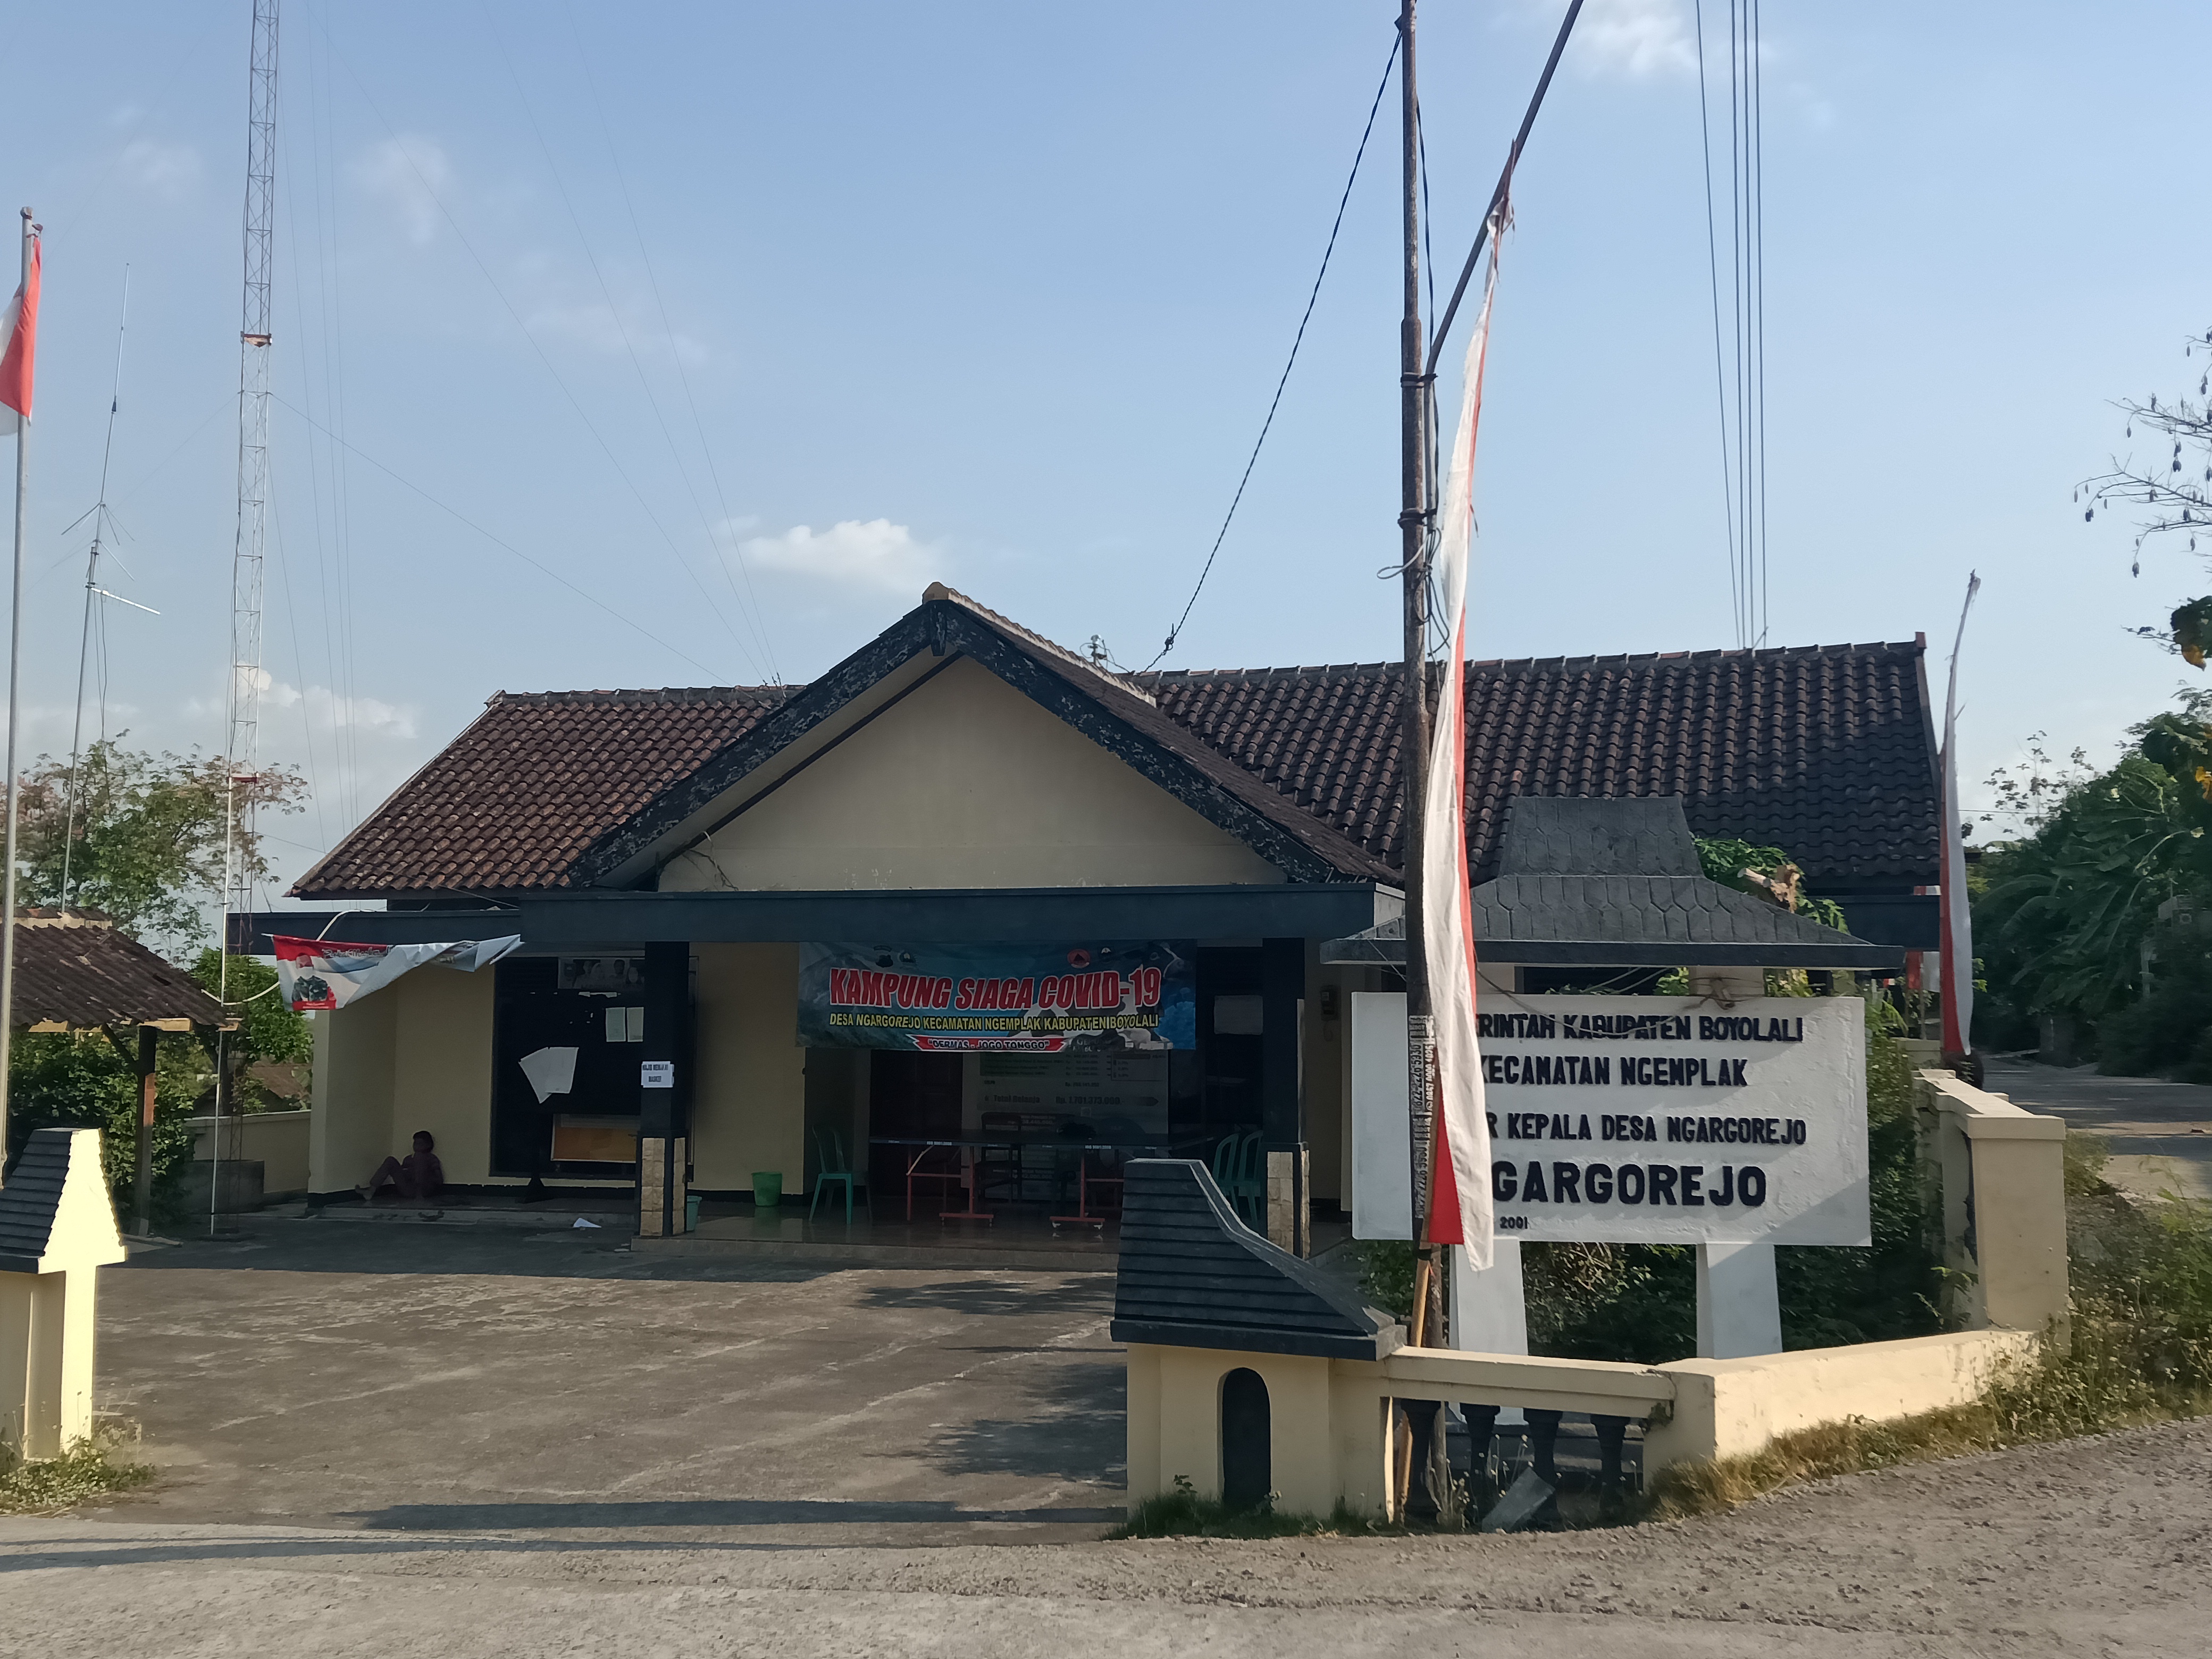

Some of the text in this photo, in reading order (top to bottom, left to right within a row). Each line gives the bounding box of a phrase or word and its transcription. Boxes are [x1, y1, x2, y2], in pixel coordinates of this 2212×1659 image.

[830, 966, 1161, 1010] KAMPUNG SIAGA COVID-19
[830, 1013, 854, 1026] DESA
[856, 1014, 921, 1029] NGARGOREJO
[923, 1017, 982, 1030] KECAMATAN
[984, 1016, 1042, 1030] NGEMPLAK
[1476, 1013, 1803, 1042] RINTAH KABUPATEN BOYOLALI
[977, 1040, 1003, 1050] JOGO
[1620, 1057, 1748, 1086] NGEMPLAK
[1507, 1112, 1593, 1140] KEPALA
[1601, 1114, 1657, 1142] DESA
[1666, 1116, 1806, 1145] NGARGOREJO
[1491, 1161, 1766, 1207] GARGOREJO
[1499, 1216, 1528, 1229] 2001
